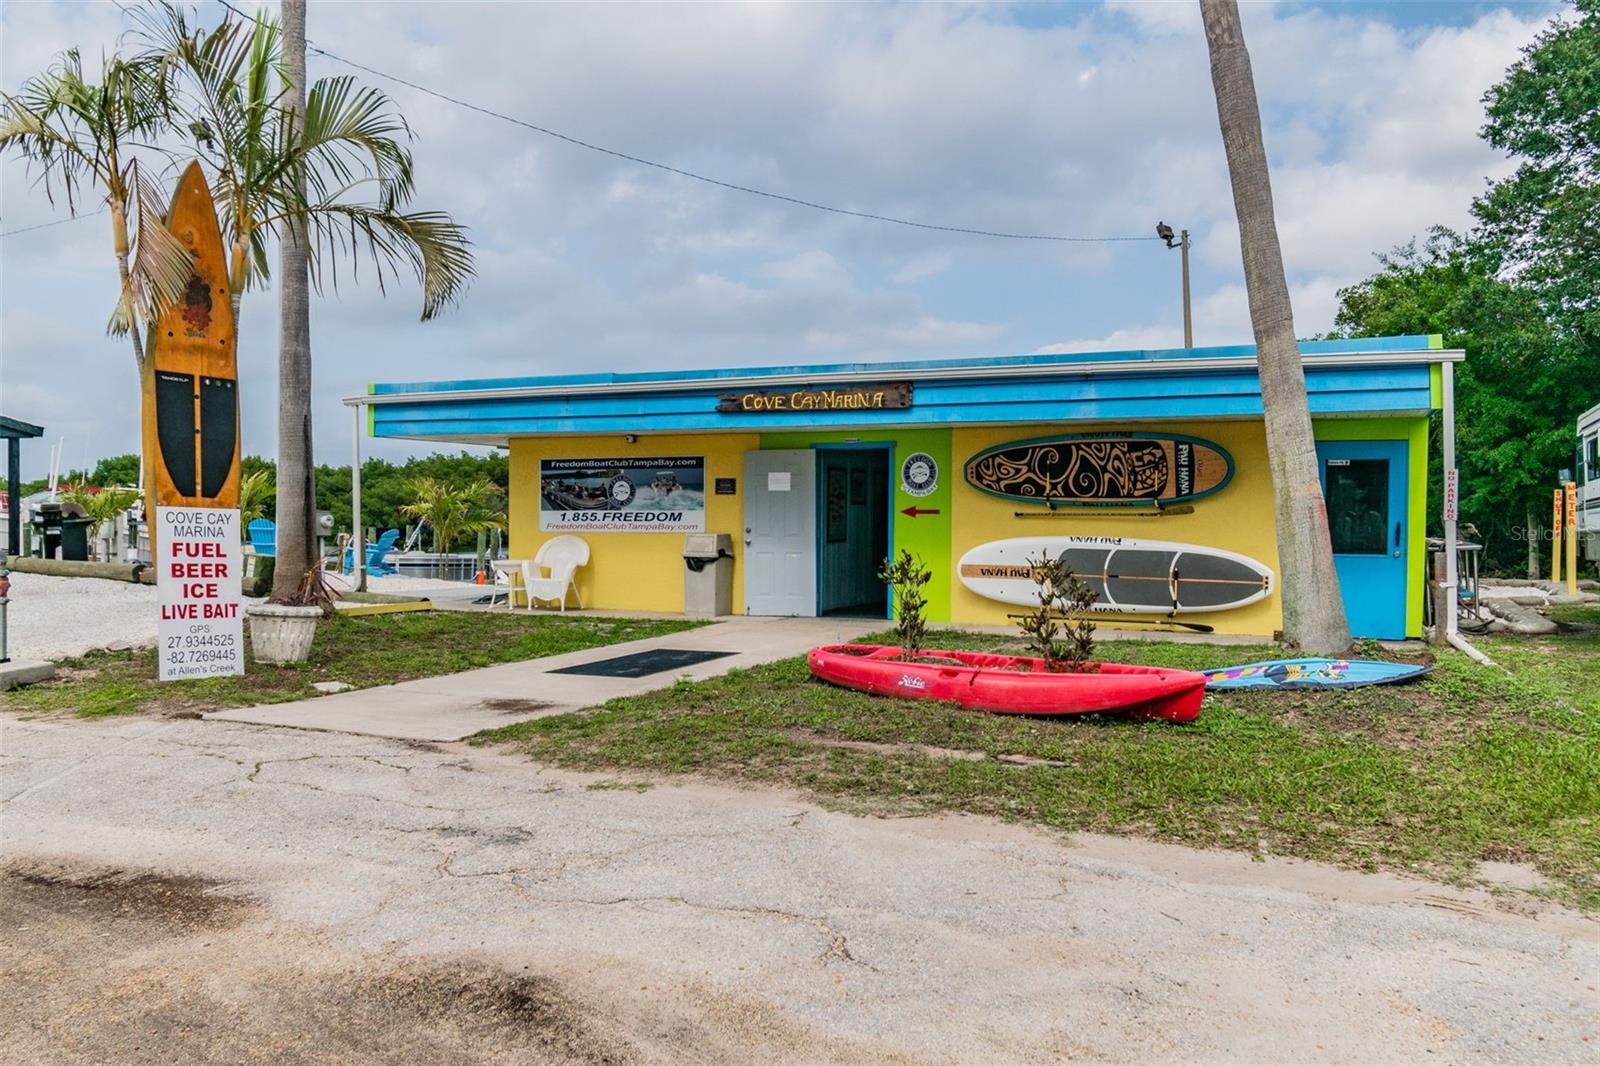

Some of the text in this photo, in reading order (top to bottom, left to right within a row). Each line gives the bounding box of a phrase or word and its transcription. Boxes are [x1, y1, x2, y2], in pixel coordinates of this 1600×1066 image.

[743, 391, 884, 409] COVE CAY MARINA
[551, 459, 696, 468] FreedomBoatClubTampaBay.com
[1179, 444, 1190, 495] PAU HANA
[1447, 470, 1455, 519] NO PARKING
[1567, 484, 1576, 526] METER
[166, 512, 232, 525] COVE CAY
[559, 512, 683, 522] 1.855.FREEDOM
[174, 526, 225, 538] MARINA
[172, 542, 227, 558] FUEL
[171, 563, 228, 578] BEER
[980, 568, 1030, 578] PAU HANA
[183, 583, 218, 599] ICE
[162, 603, 239, 620] LIVE BAIT
[168, 634, 234, 649] 27.9344525
[167, 649, 236, 664] -82.7269445
[167, 664, 236, 676] at Allen's Creek
